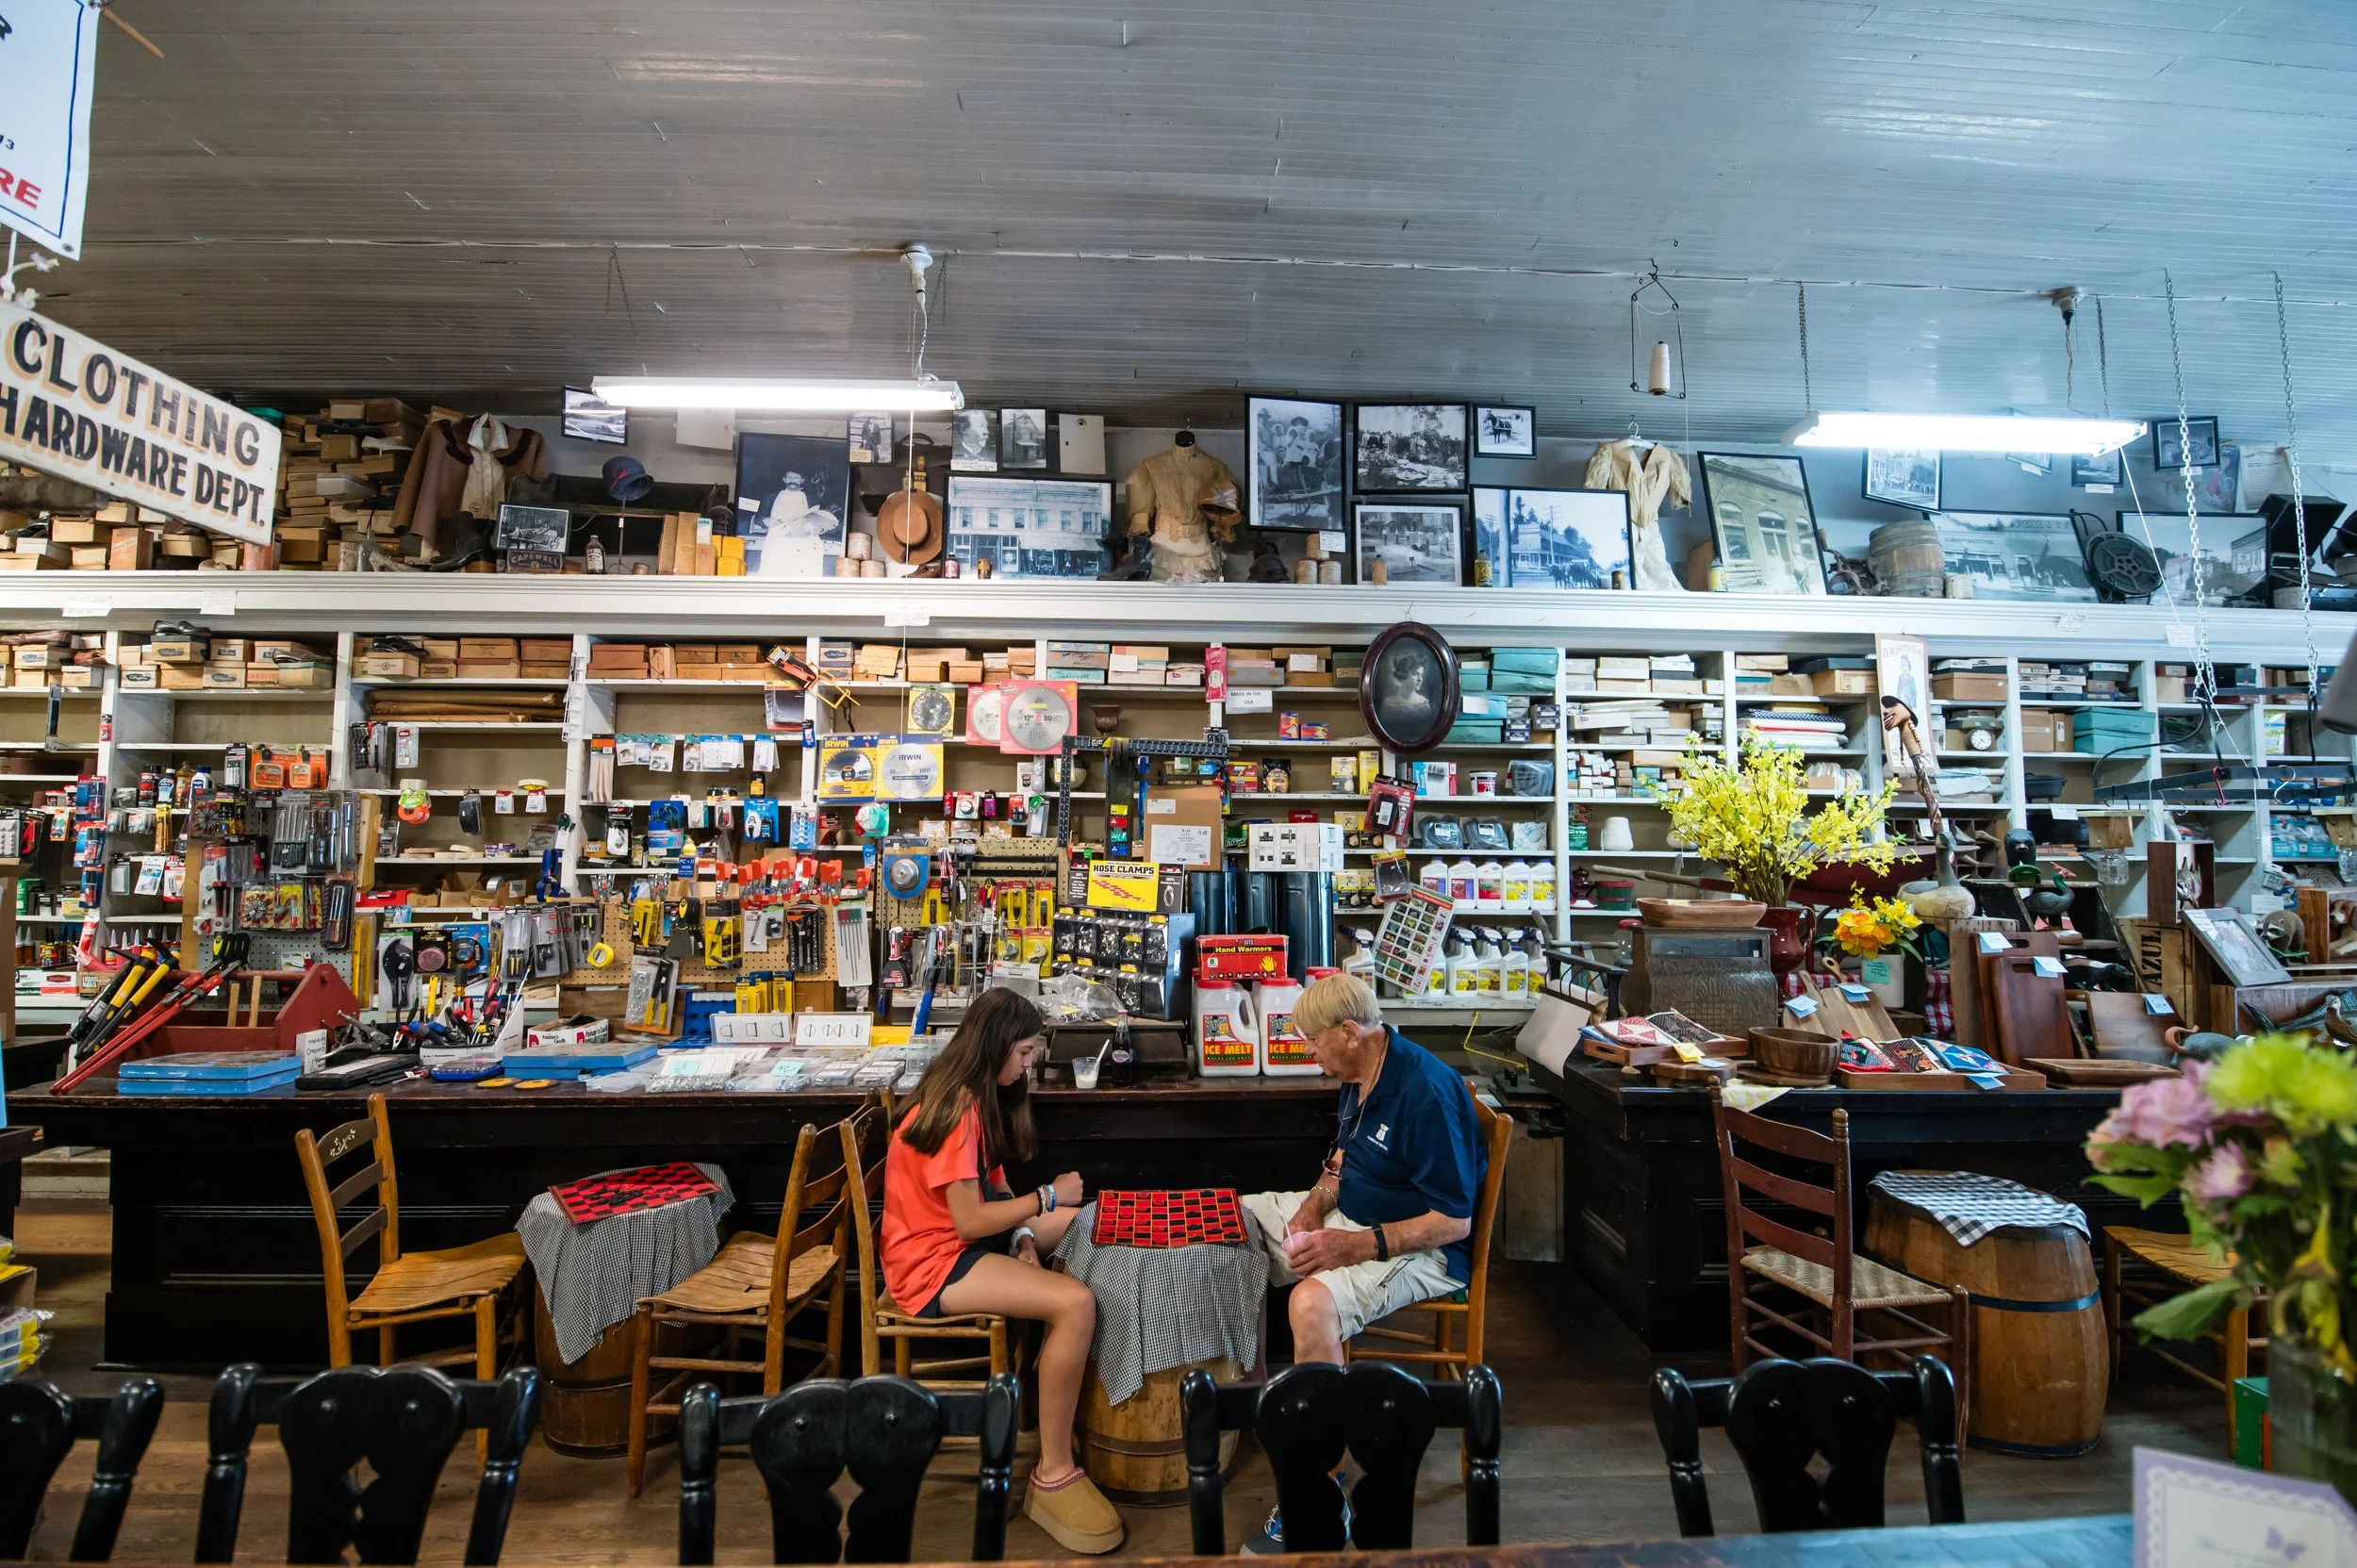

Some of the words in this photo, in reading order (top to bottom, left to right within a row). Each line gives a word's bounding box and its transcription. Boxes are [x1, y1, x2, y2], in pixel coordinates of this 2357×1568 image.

[9, 319, 260, 469] CLOTHING
[0, 382, 188, 498] HARDWARE
[194, 463, 266, 528] DEPT.
[511, 553, 558, 566] CAPEWELL
[1117, 866, 1155, 874] CLAMPS
[2141, 931, 2163, 987] AZUL
[1204, 1045, 1220, 1054] ICE
[1224, 1045, 1252, 1054] MELT
[1269, 1044, 1285, 1053] ICE
[1289, 1044, 1306, 1053] ME
